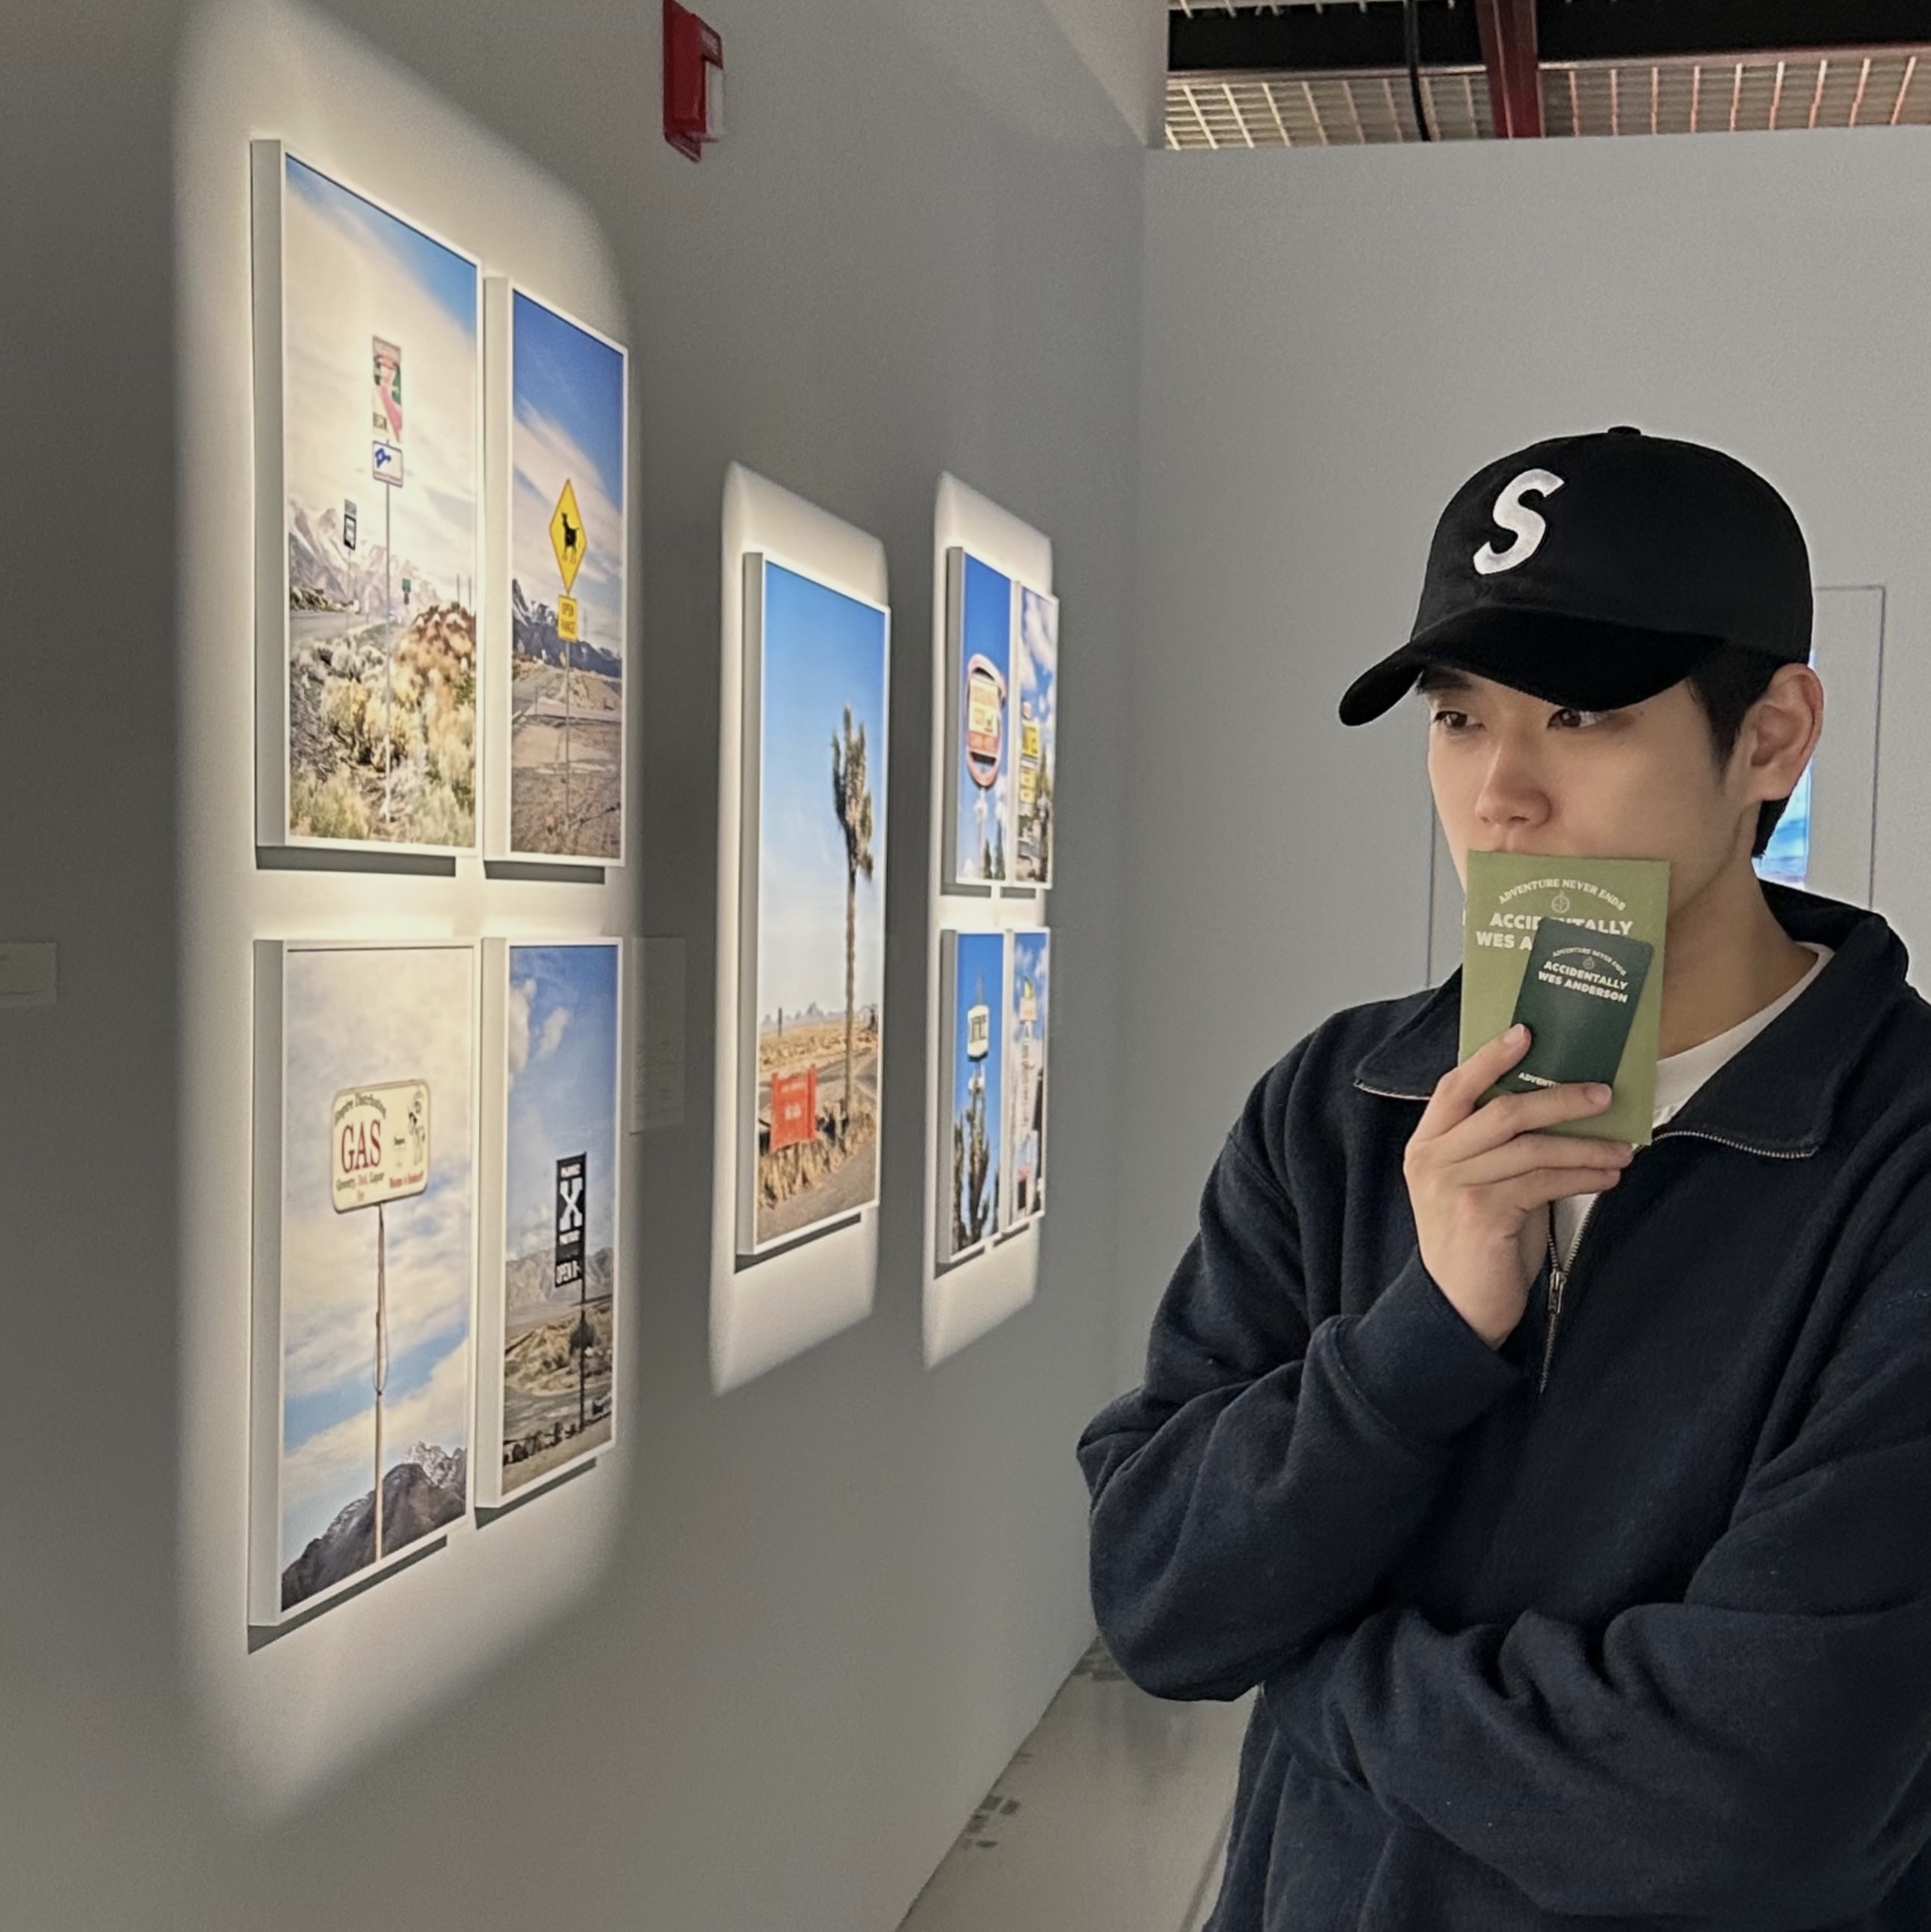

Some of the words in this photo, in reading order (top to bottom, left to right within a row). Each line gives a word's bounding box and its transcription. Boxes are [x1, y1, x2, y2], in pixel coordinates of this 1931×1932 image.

[1473, 468, 1565, 575] S
[1499, 878, 1560, 904] ADVENTURE
[1562, 879, 1599, 895] NEVER
[1598, 889, 1627, 911] ENDS
[1476, 931, 1515, 949] WES
[1538, 971, 1563, 986] WES
[1563, 979, 1629, 1004] ANDERSON
[1543, 961, 1629, 990] ACCIDENTALLY
[341, 1119, 381, 1173] GAS
